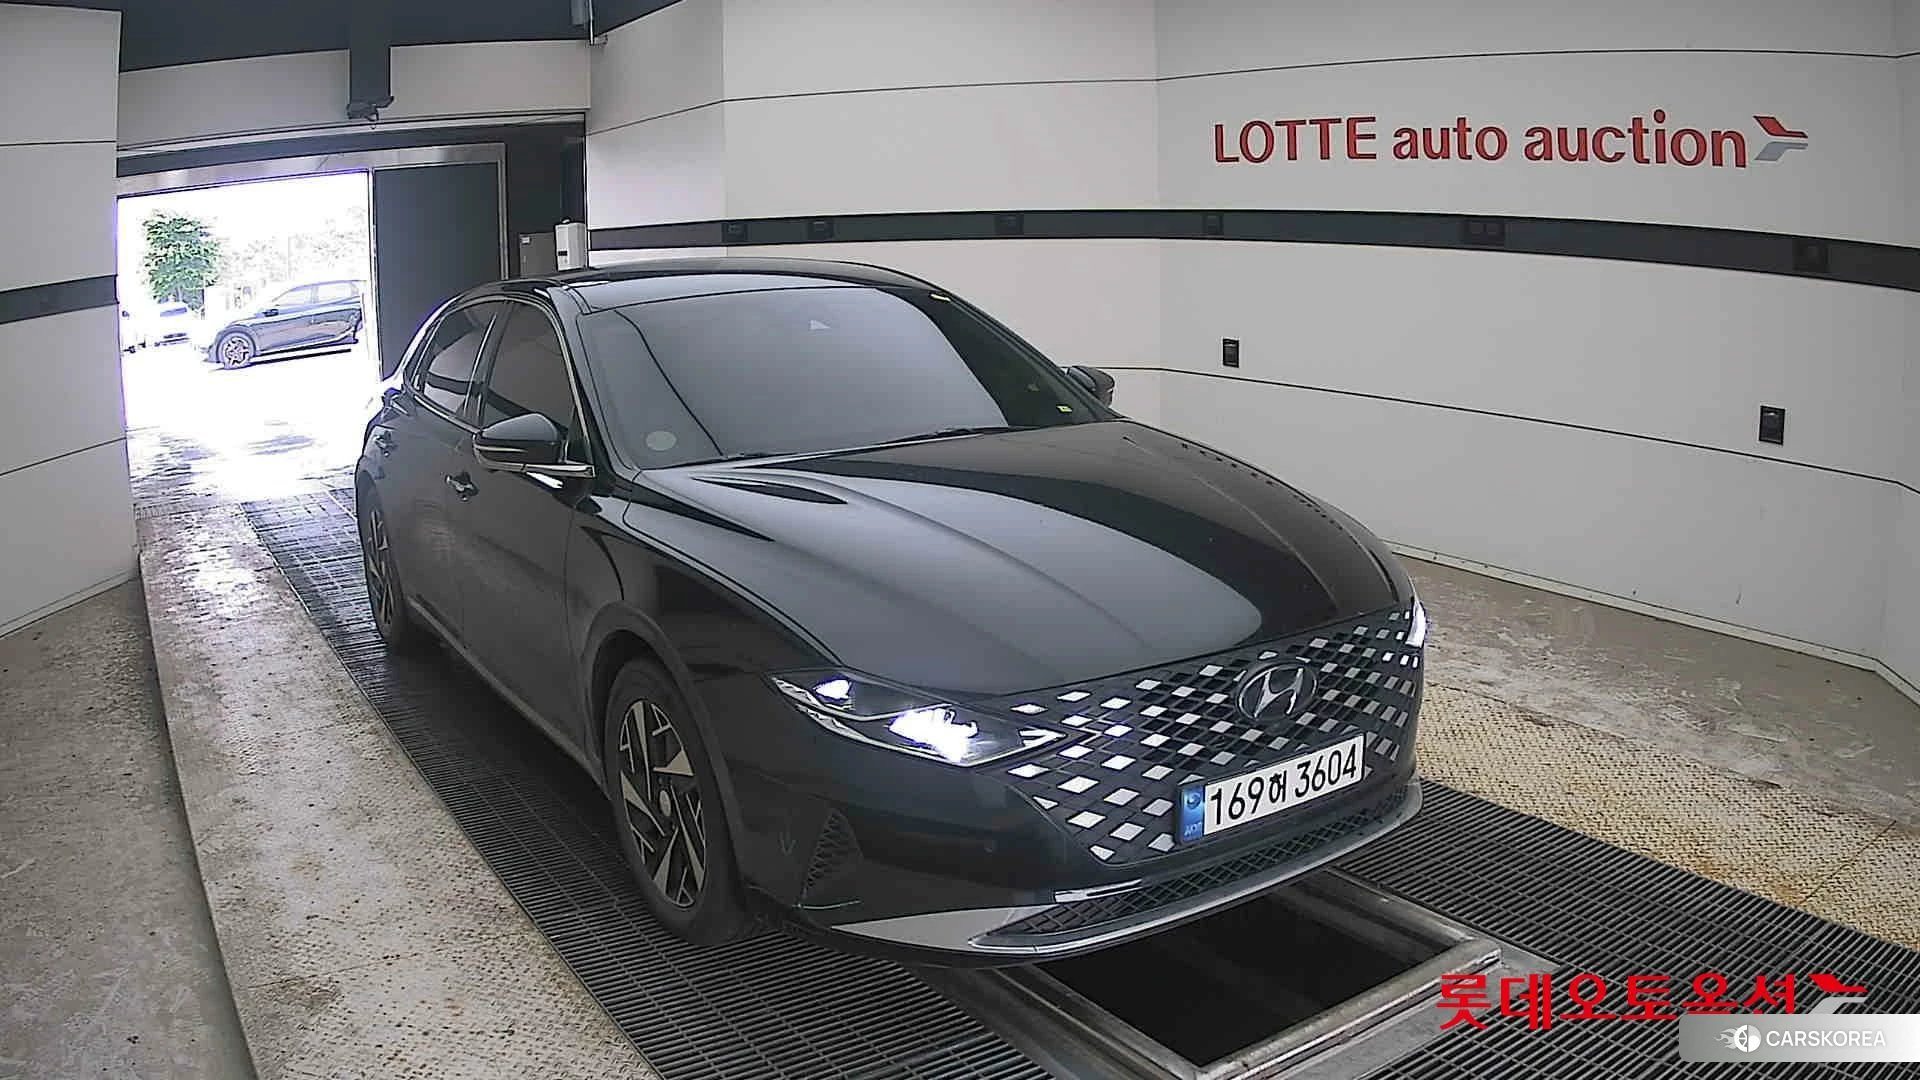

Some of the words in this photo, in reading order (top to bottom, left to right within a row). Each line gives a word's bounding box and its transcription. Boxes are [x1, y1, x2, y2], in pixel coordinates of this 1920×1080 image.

[1214, 116, 1377, 163] LOTTE
[1392, 117, 1508, 161] auto
[1523, 109, 1747, 169] auction
[1210, 770, 1288, 825] 169허
[1294, 743, 1357, 799] 3604
